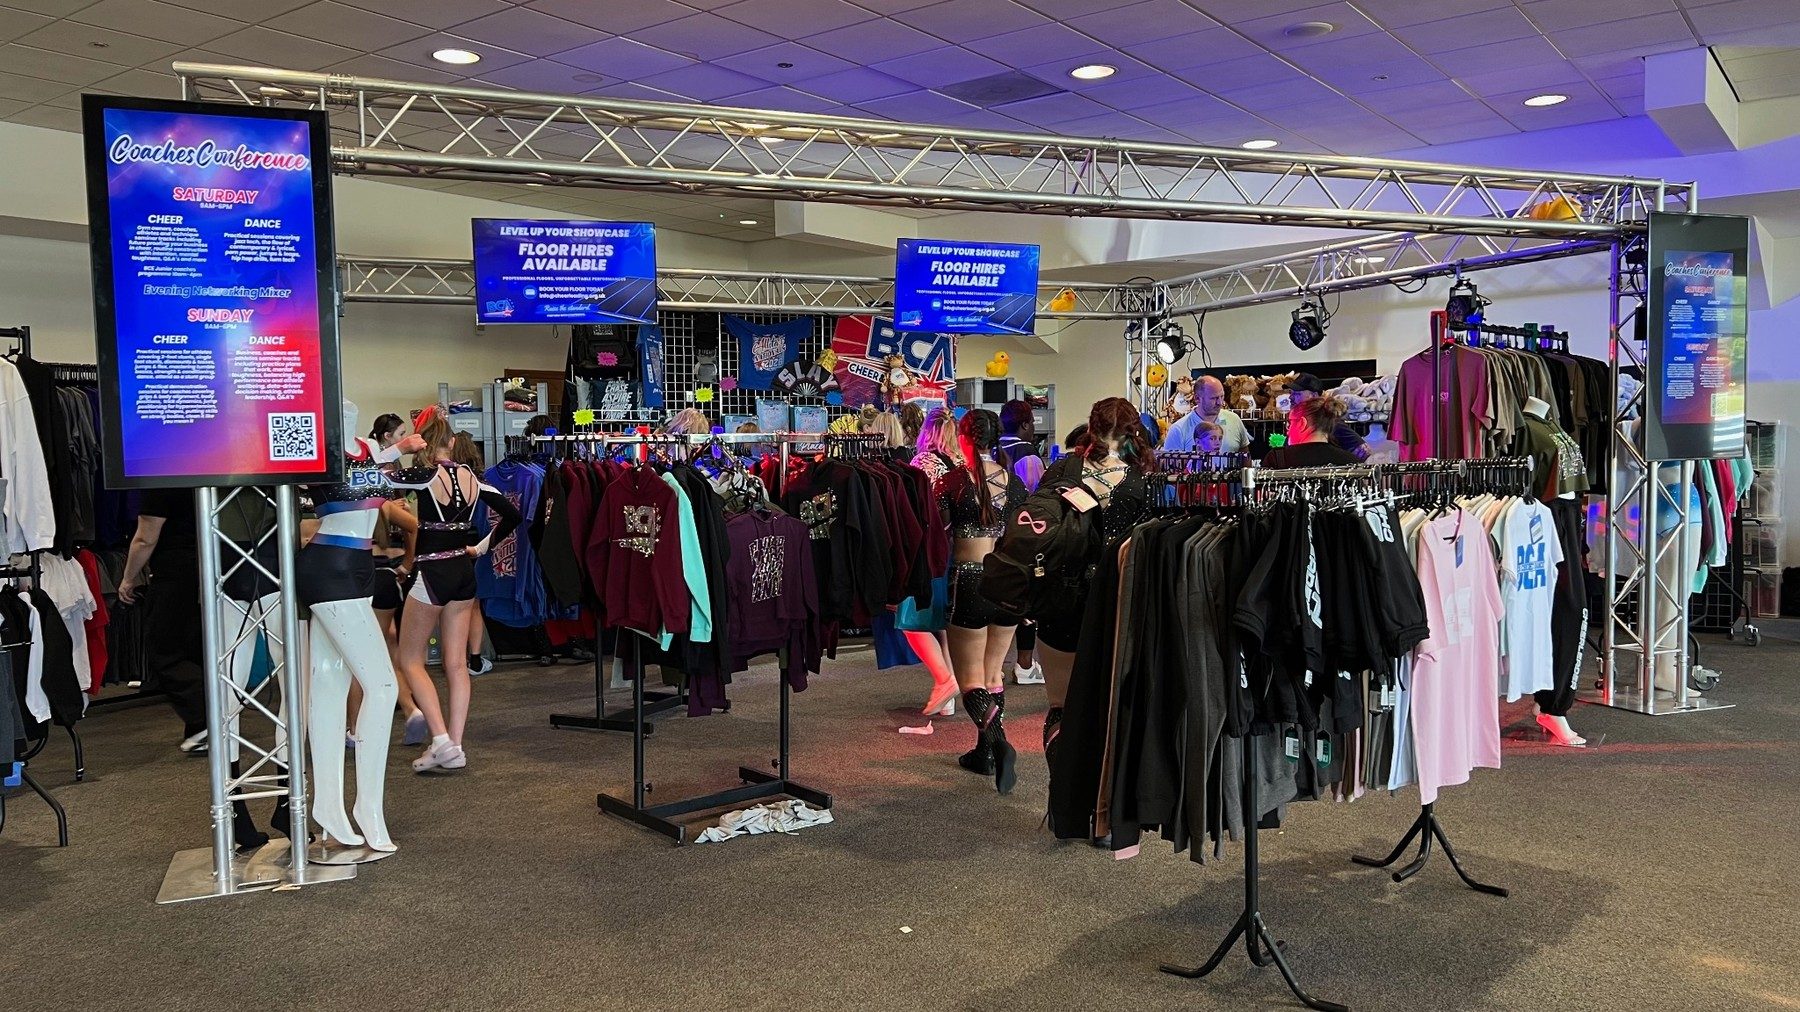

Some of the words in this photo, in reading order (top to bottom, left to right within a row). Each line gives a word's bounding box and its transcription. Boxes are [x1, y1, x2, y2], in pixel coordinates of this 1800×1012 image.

[110, 134, 194, 165] Coaches
[194, 140, 309, 171] Conference
[173, 187, 258, 204] SATURDAY
[148, 215, 183, 225] CHEER
[244, 219, 281, 228] DANCE
[500, 226, 529, 236] LEVEL
[530, 227, 545, 236] UP
[545, 228, 574, 237] YOUR
[574, 228, 631, 238] SHOWCASE
[519, 243, 570, 256] FLOOR
[570, 244, 614, 257] HIRES
[918, 246, 942, 255] LEVEL
[942, 247, 953, 255] UP
[953, 247, 975, 256] YOUR
[975, 249, 1020, 258] SHOWCASE
[522, 258, 607, 271] AVAILABLE
[931, 261, 970, 273] FLOOR
[971, 262, 1006, 275] HIRES
[932, 274, 999, 287] AVAILABLE
[143, 284, 190, 298] Evening
[192, 285, 258, 299] Networking
[259, 286, 291, 298] Mixer
[187, 308, 254, 322] SUNDAY
[153, 335, 188, 344] CHEER
[249, 336, 285, 345] DANCE
[866, 316, 956, 383] BCA
[778, 361, 838, 390] SLAY
[848, 362, 880, 382] CHEER
[606, 384, 629, 393] CHASE
[602, 392, 633, 402] ASPIRE
